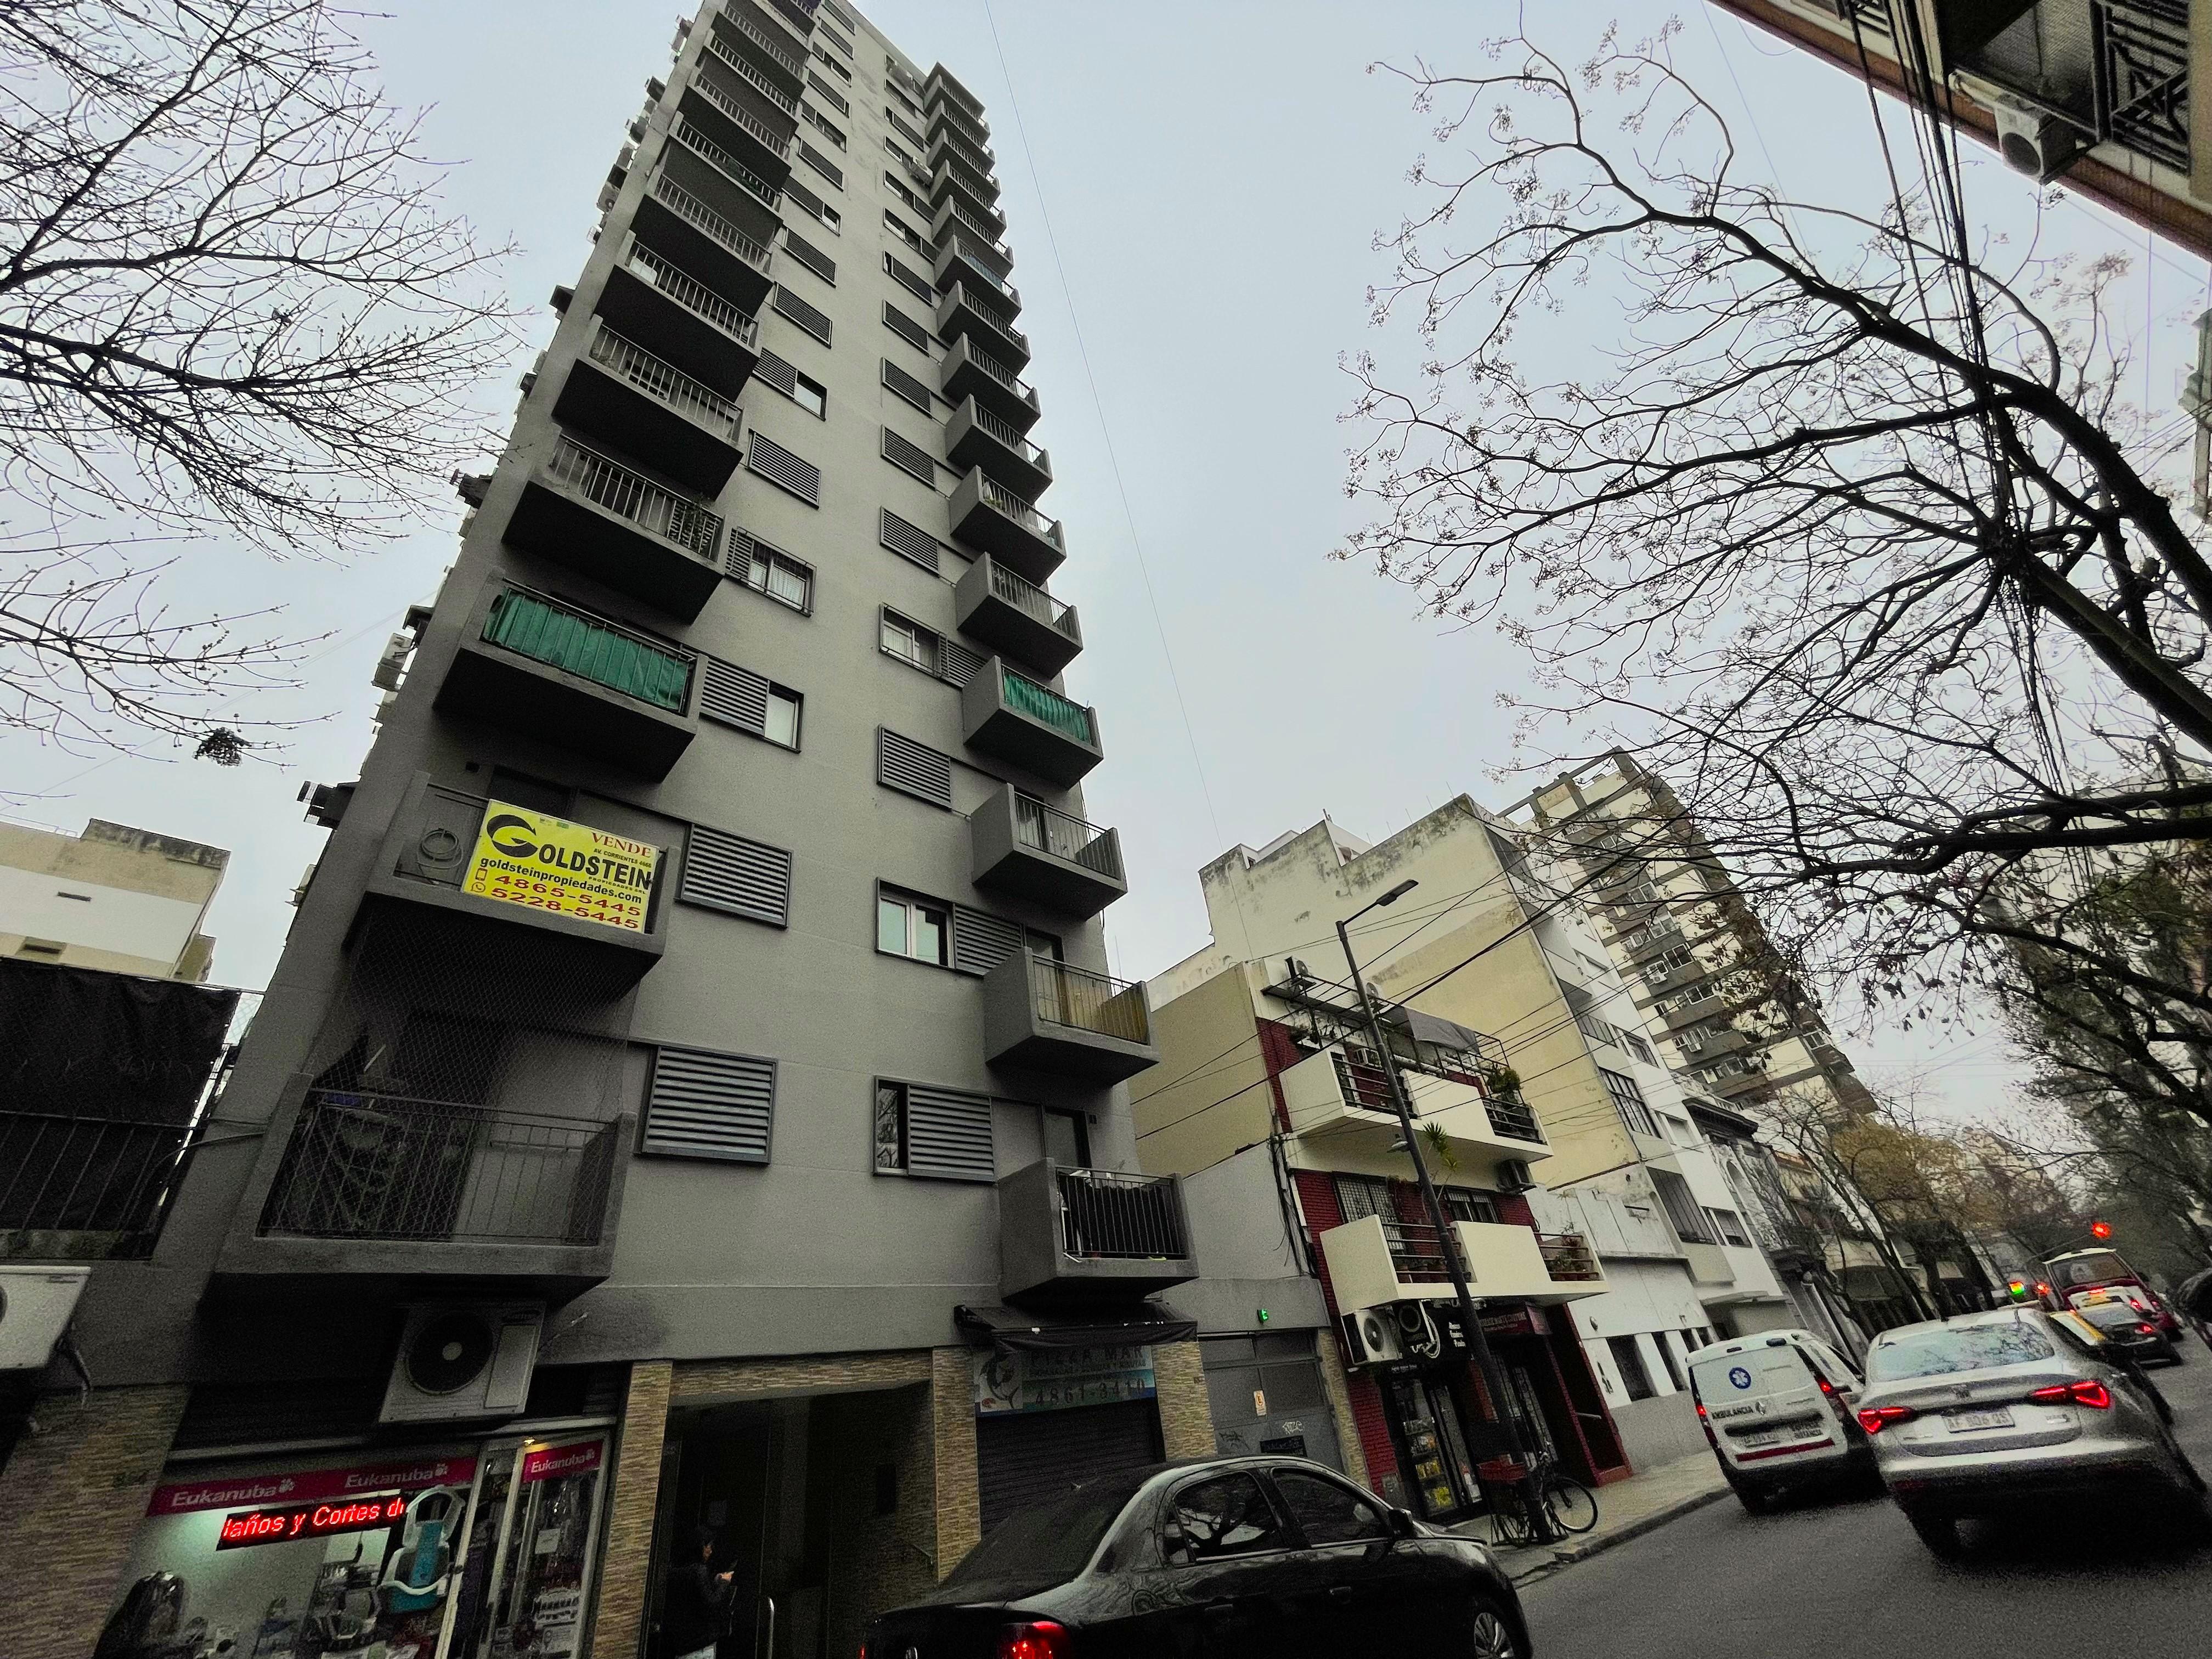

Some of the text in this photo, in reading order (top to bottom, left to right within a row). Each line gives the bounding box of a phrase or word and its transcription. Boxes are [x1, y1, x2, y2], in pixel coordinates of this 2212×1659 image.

[592, 832, 651, 858] VENDE
[603, 851, 637, 864] CORRIENTES
[480, 858, 642, 904] goldsteinpropiedades.com
[588, 876, 633, 891] PROPIEDADES
[494, 876, 641, 916] 4865-5445
[491, 888, 639, 929] 5228-5445
[1711, 1406, 1754, 1419] AMBULANCIA
[531, 1454, 585, 1473] Eukanuba
[345, 1468, 435, 1488] Eukanuba
[172, 1484, 277, 1506] Eukanuba
[290, 1513, 306, 1535] y
[313, 1504, 381, 1526] Cortes
[386, 1497, 404, 1517] d
